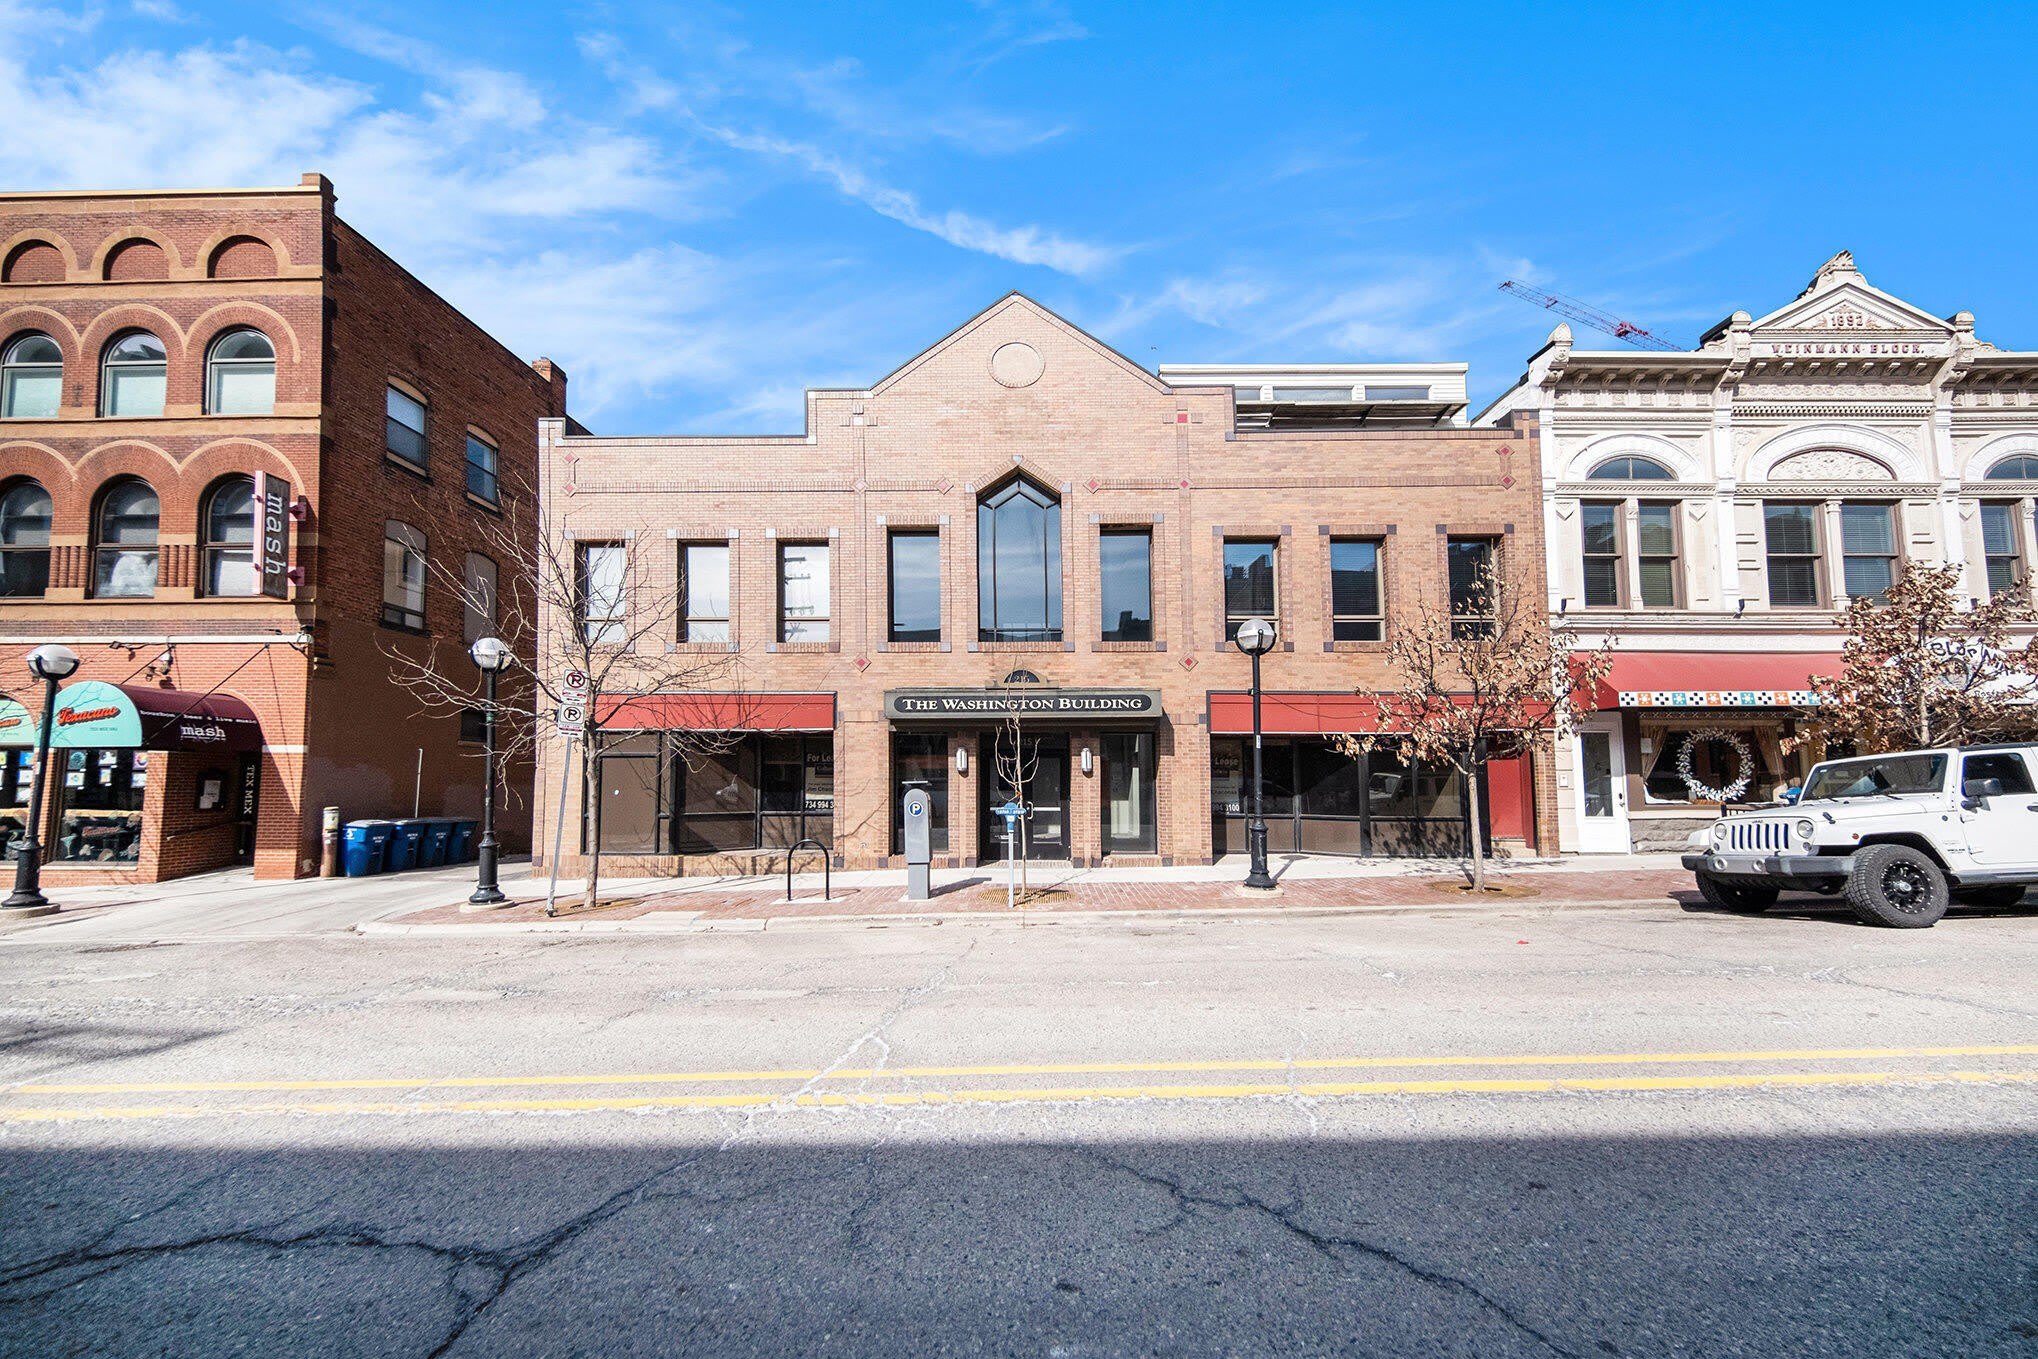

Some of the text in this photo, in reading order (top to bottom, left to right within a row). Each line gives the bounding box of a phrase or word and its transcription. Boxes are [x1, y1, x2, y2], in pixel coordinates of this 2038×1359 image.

[1831, 315, 1864, 327] 1892
[266, 492, 286, 575] mash
[902, 698, 1142, 710] THE WASHINGTON BUILDING
[180, 725, 226, 738] mash
[243, 764, 255, 814] TEX MEX
[805, 800, 816, 809] 734
